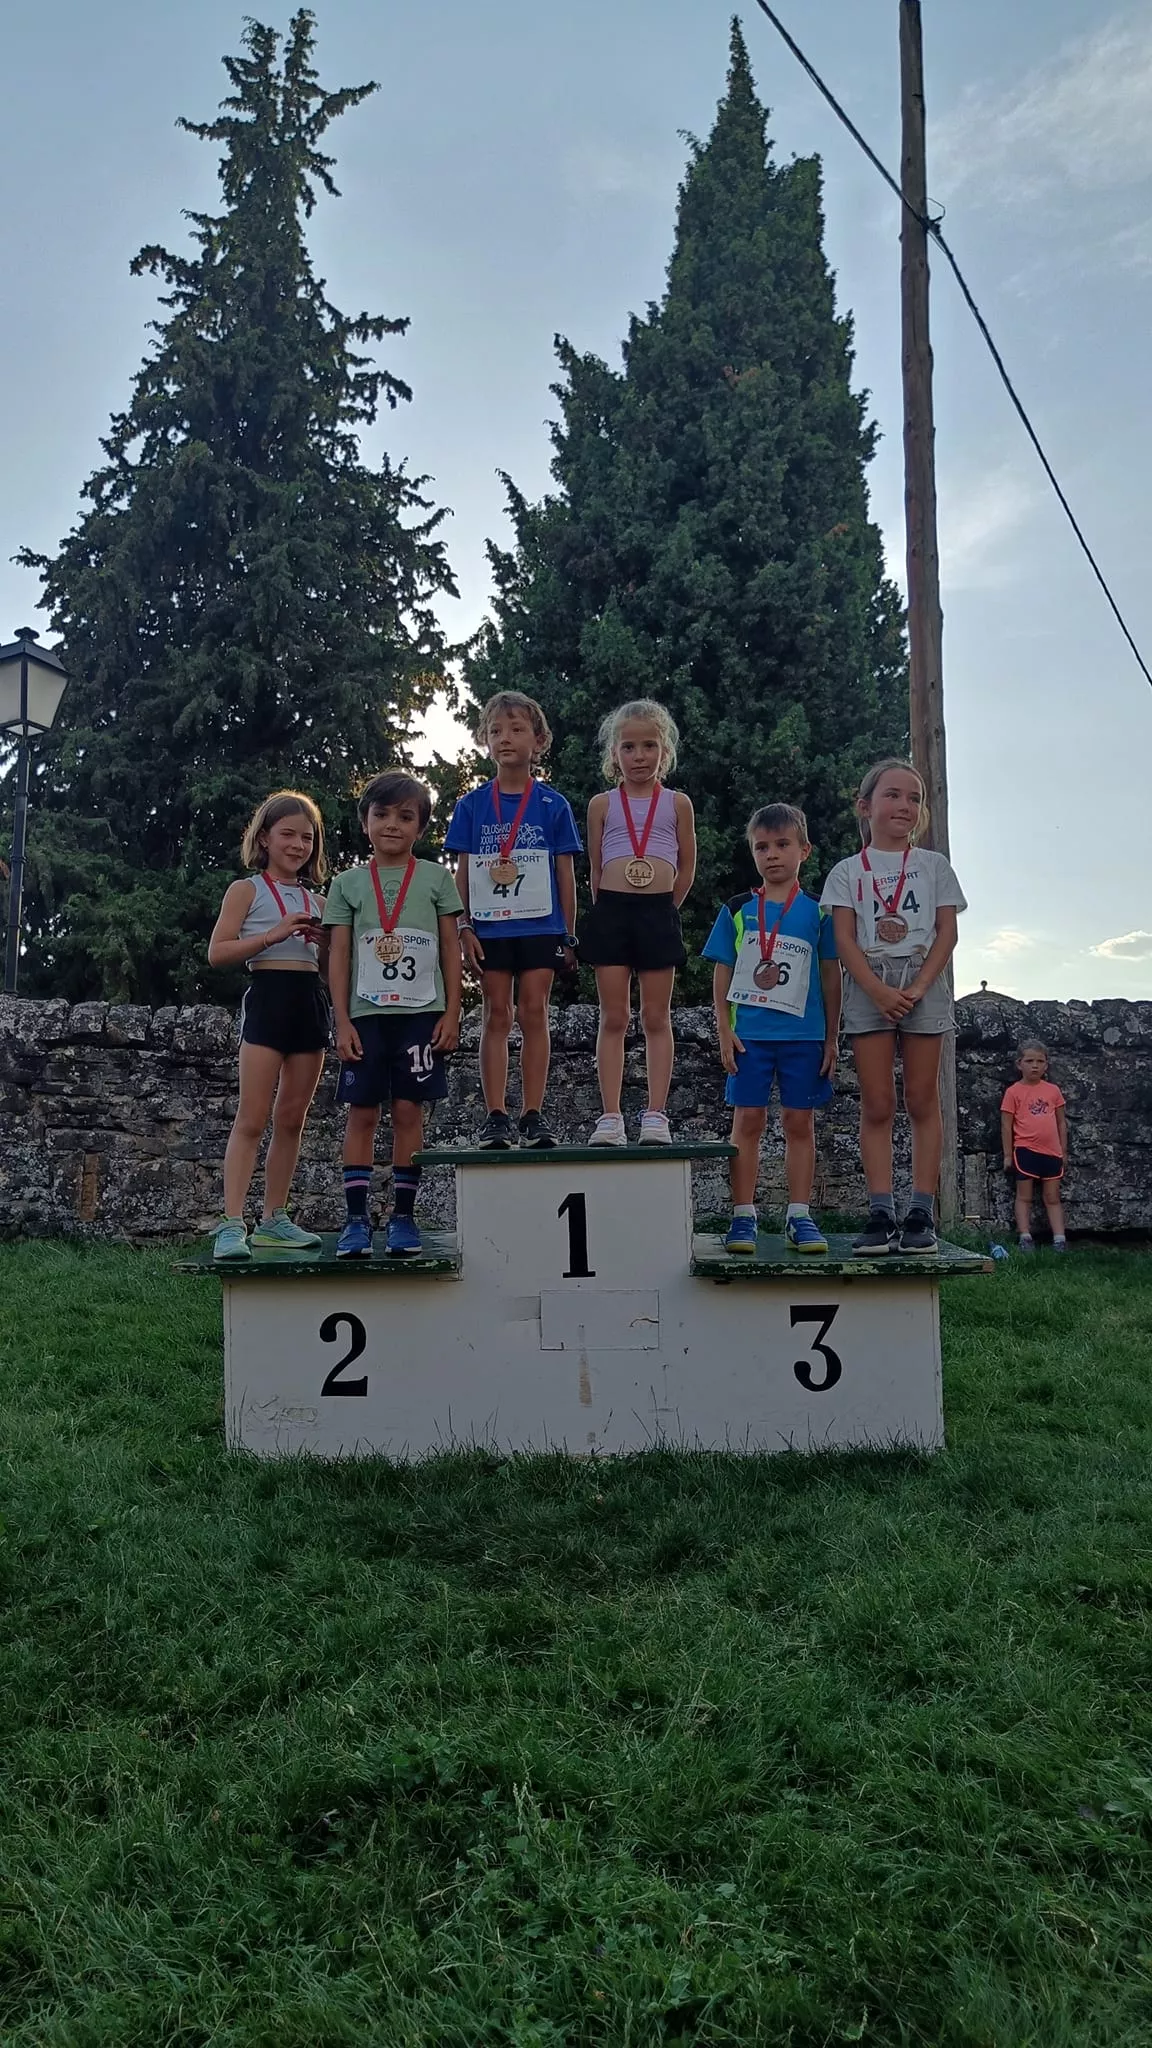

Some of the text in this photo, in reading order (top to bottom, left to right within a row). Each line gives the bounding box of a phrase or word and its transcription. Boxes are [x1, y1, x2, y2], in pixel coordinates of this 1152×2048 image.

[479, 844, 502, 855] KRO
[493, 873, 526, 898] 47
[382, 956, 416, 981] 83
[776, 962, 792, 986] 6
[406, 1043, 434, 1073] 10
[557, 1193, 596, 1279] 1
[319, 1311, 369, 1397] 2
[789, 1304, 842, 1392] 3
